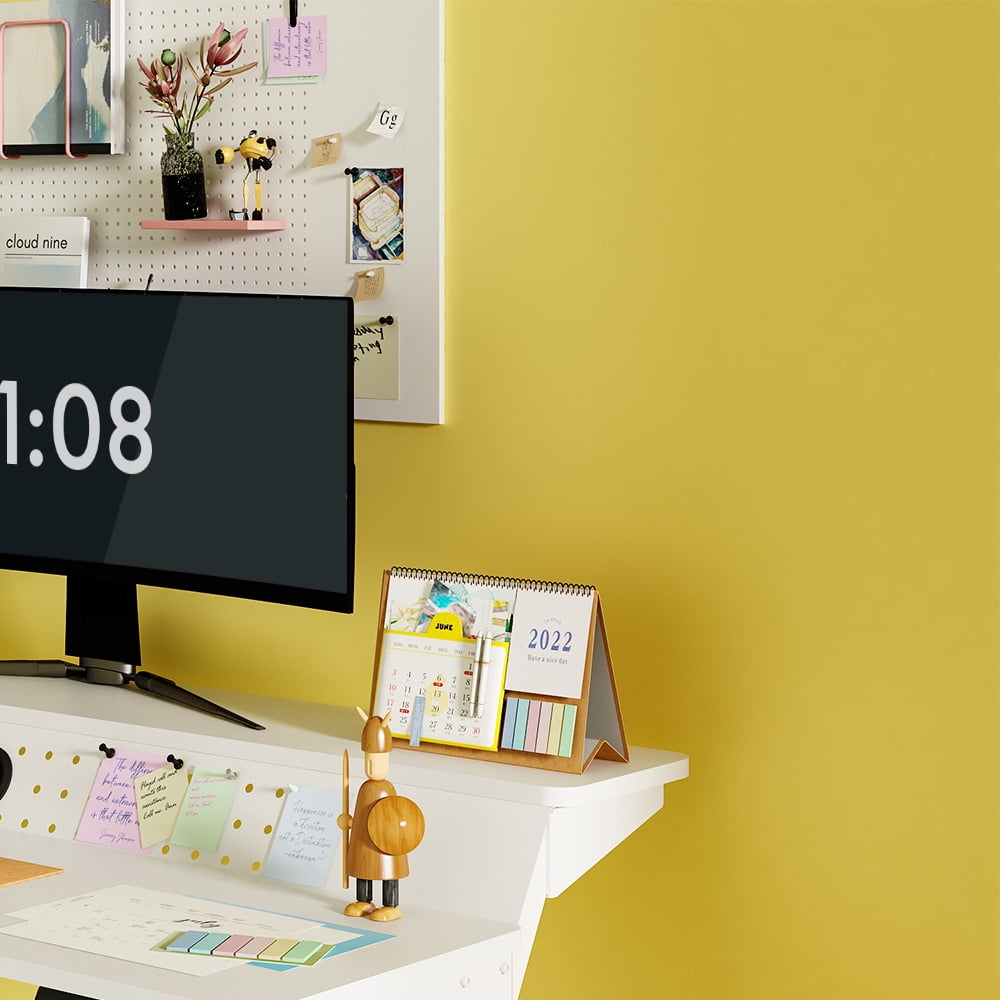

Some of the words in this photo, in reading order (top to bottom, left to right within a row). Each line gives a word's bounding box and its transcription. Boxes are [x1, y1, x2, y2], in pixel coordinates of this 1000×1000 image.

[380, 110, 398, 130] Gg
[6, 233, 39, 249] cloud
[42, 236, 68, 249] nine
[528, 628, 572, 652] 2022
[114, 758, 128, 774] The
[102, 773, 132, 787] between
[96, 791, 112, 804] and
[99, 808, 117, 821] that
